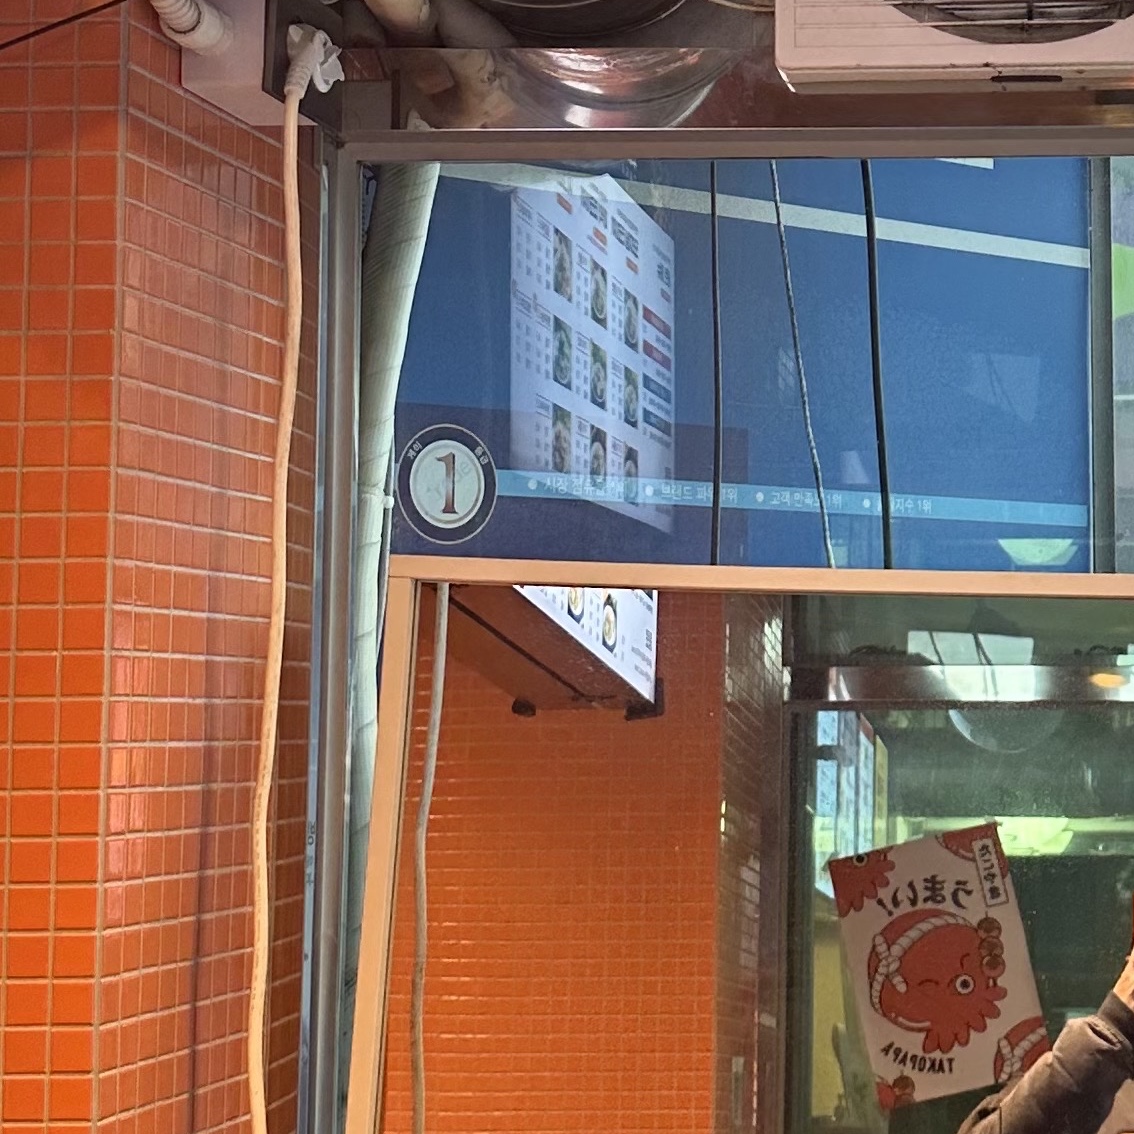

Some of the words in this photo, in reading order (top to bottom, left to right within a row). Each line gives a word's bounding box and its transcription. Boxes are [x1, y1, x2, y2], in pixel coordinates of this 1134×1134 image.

[436, 452, 459, 514] 1
[661, 483, 693, 501] 브랜드
[771, 491, 791, 506] 고객
